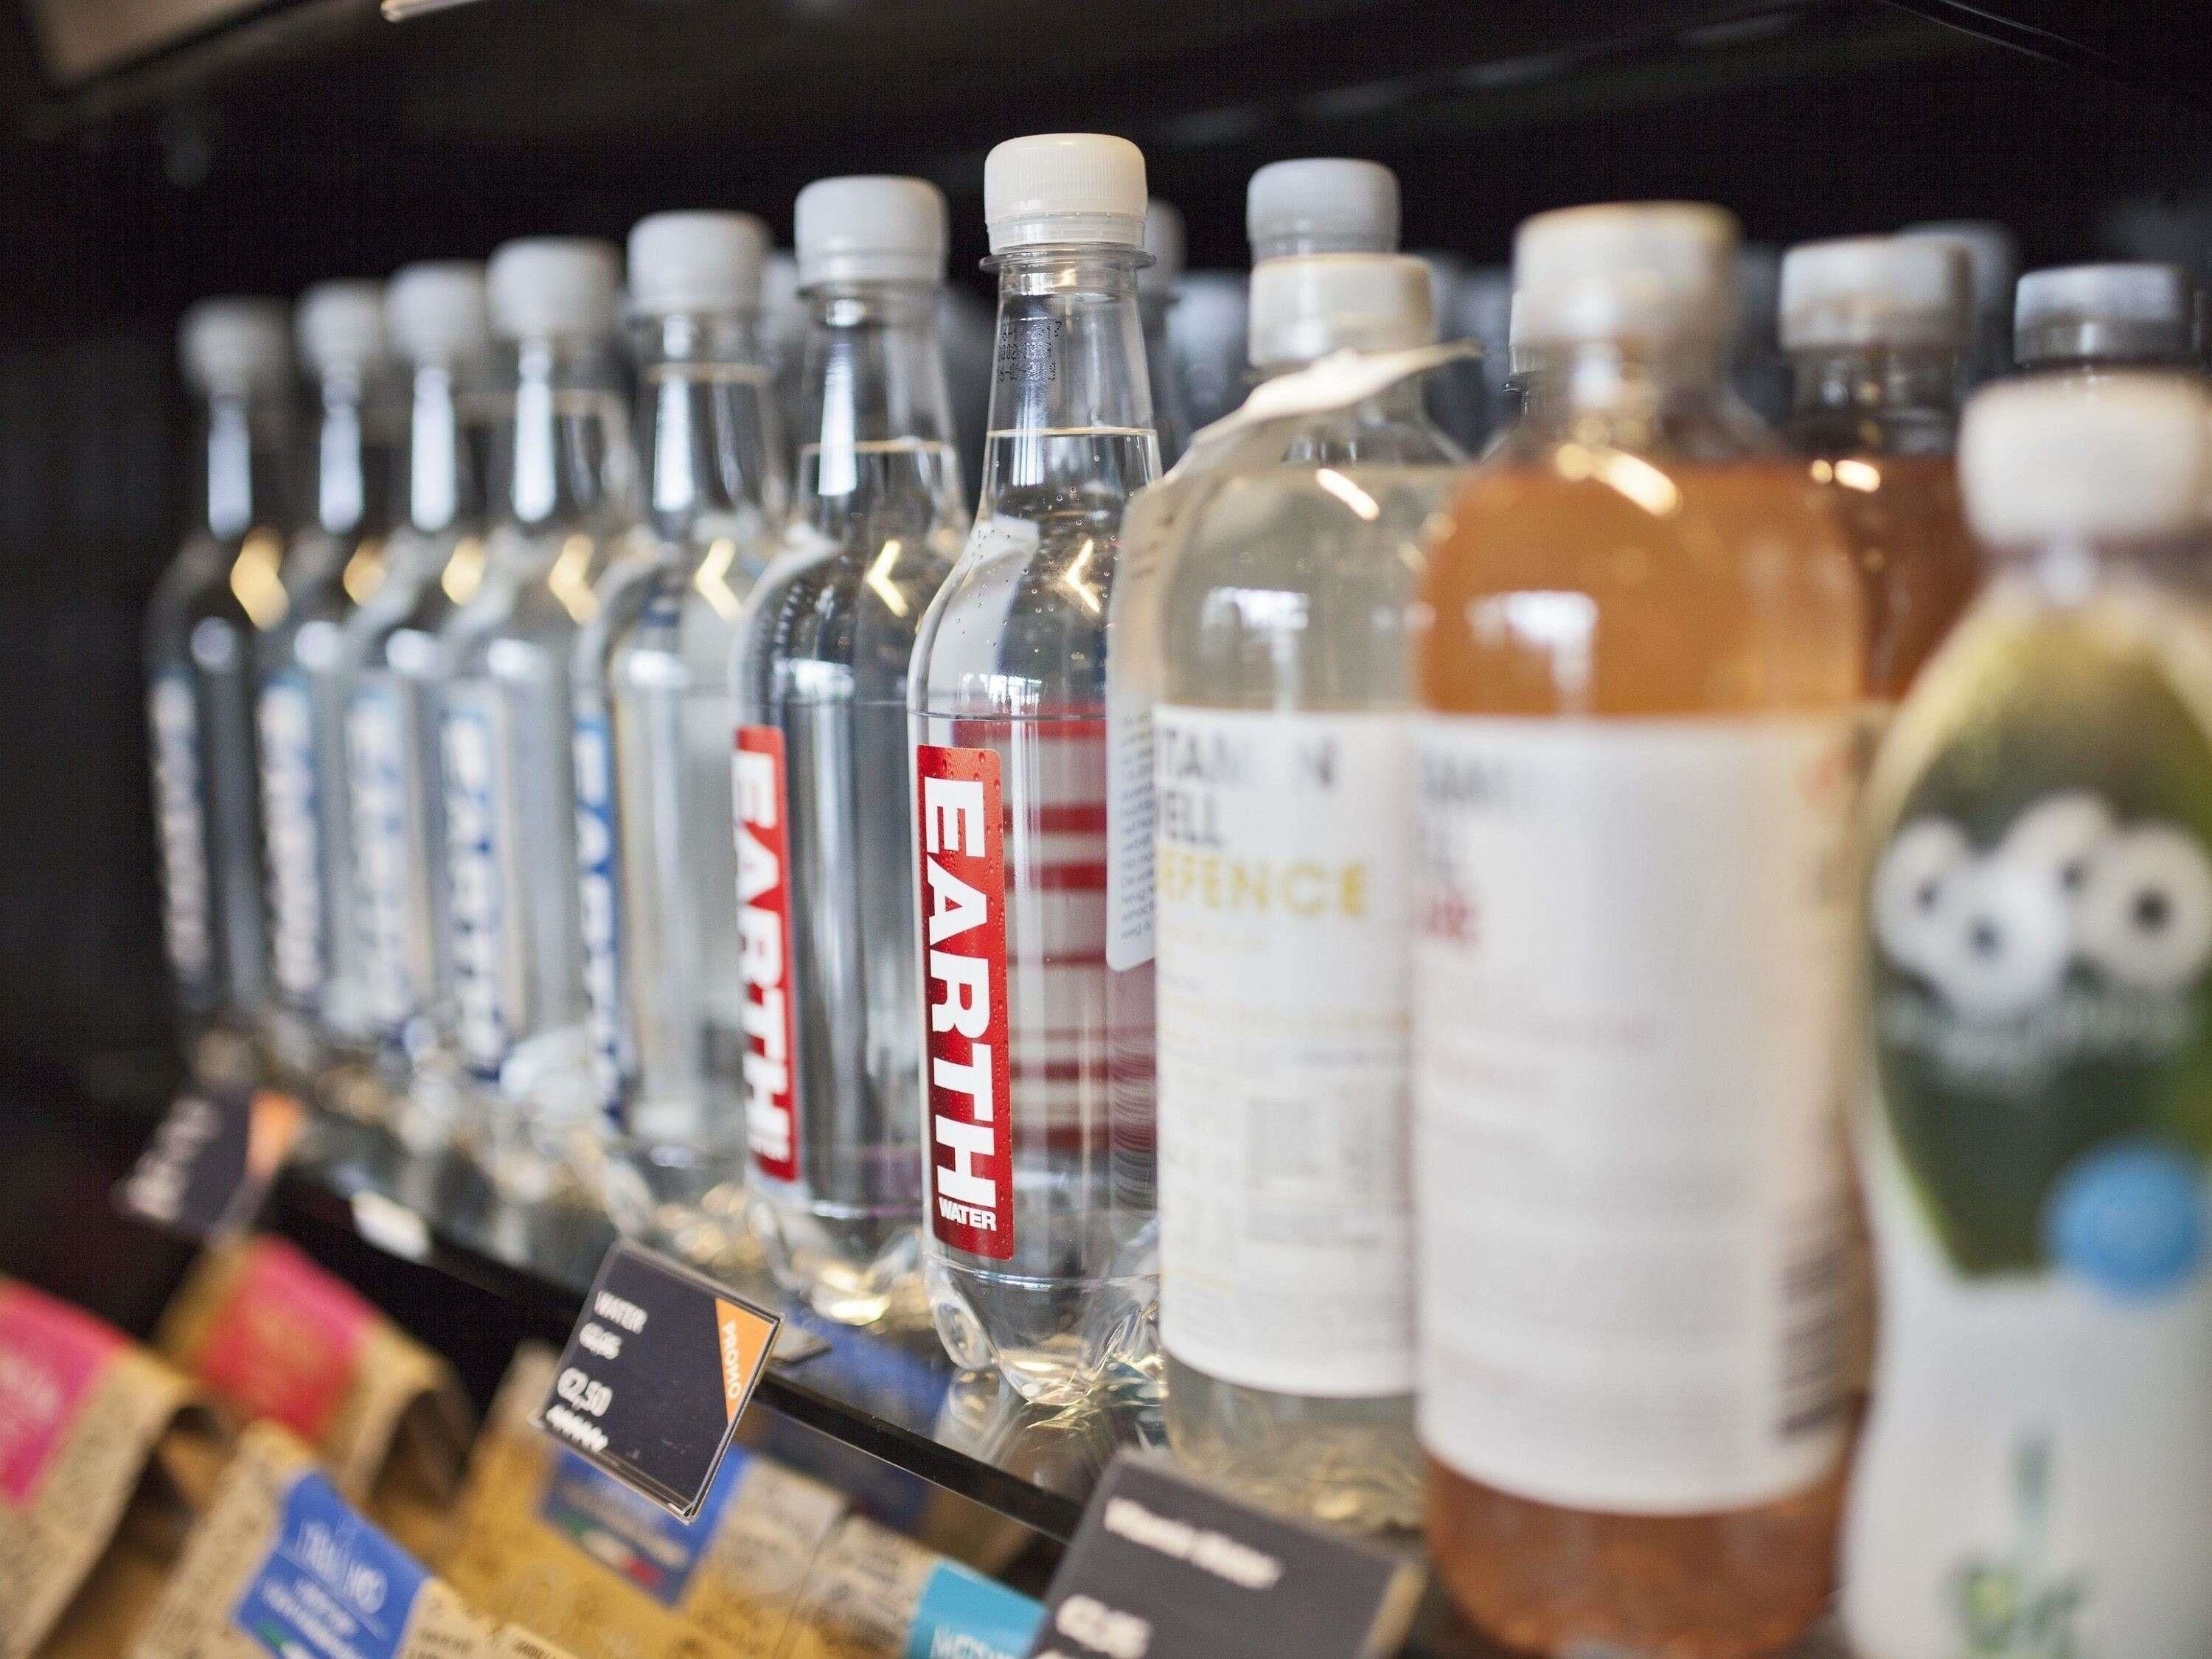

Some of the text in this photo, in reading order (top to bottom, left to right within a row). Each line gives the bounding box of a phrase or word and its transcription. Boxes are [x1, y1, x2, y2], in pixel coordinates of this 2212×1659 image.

[733, 748, 789, 1138] EARTH
[924, 776, 996, 1208] EARTH
[938, 1196, 998, 1232] WATER
[721, 1321, 742, 1400] PROMO
